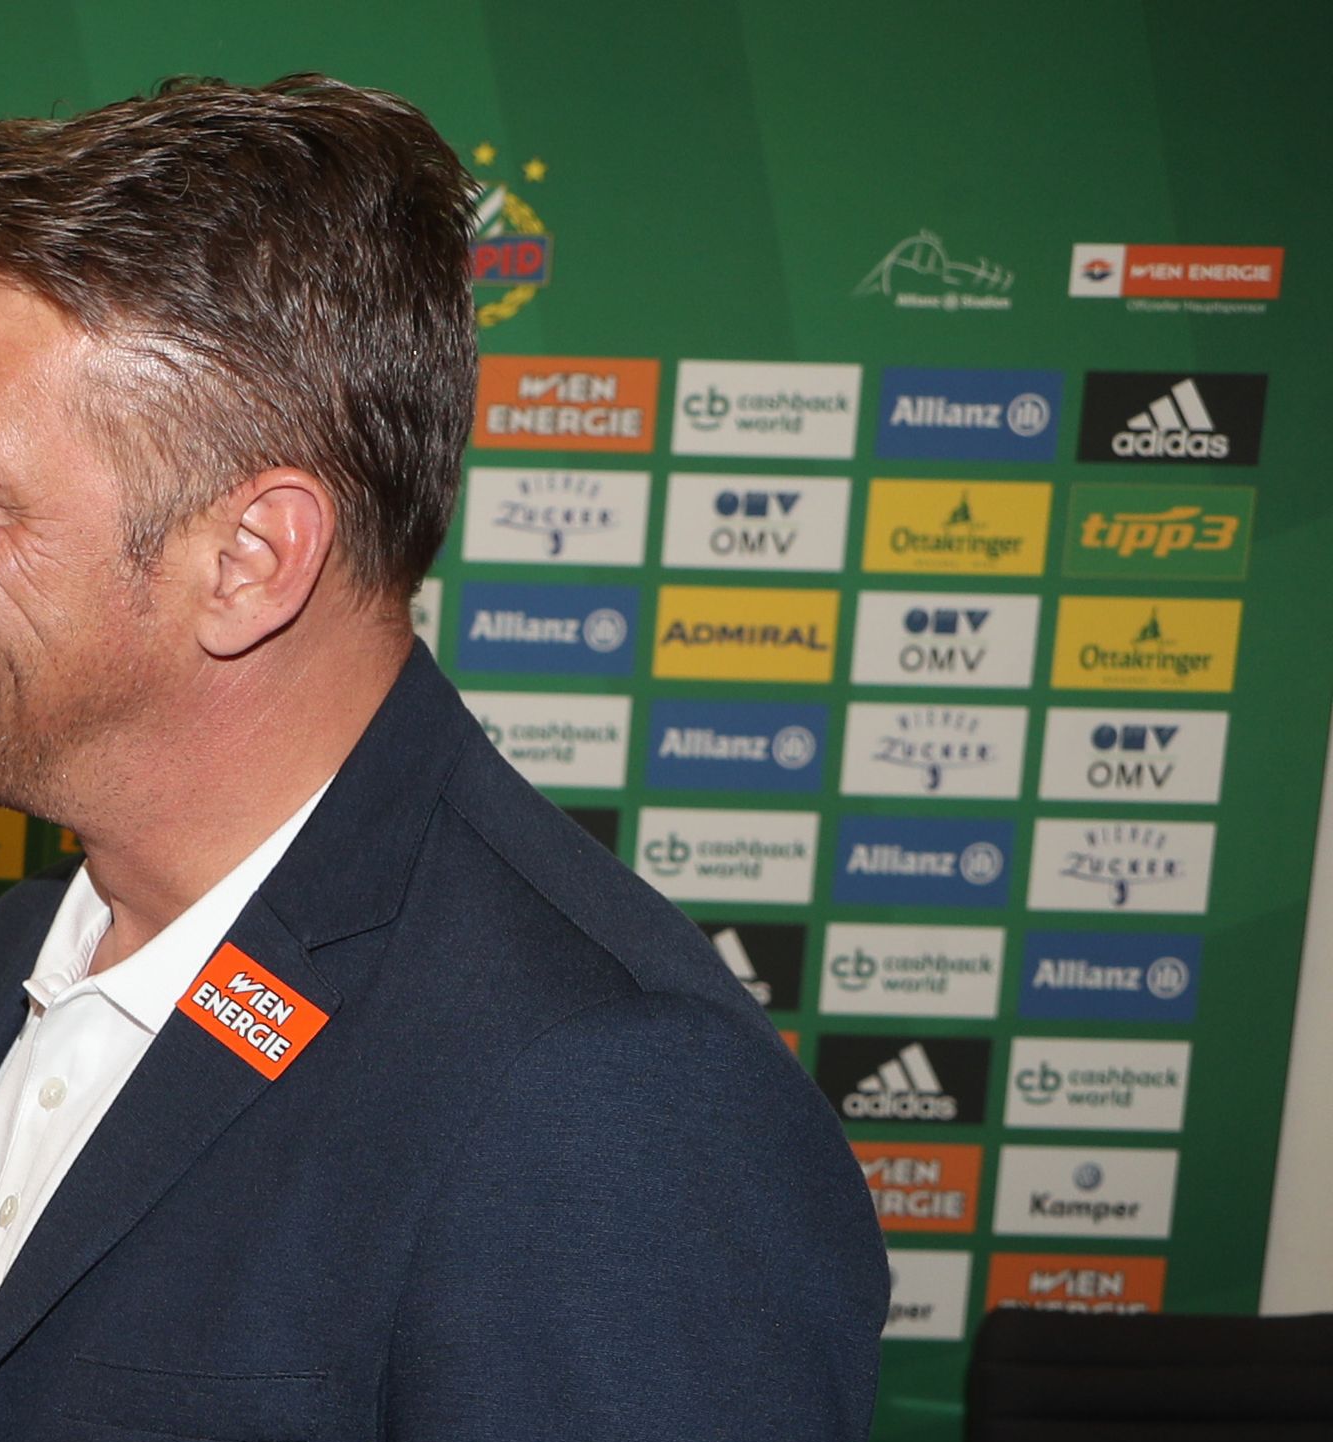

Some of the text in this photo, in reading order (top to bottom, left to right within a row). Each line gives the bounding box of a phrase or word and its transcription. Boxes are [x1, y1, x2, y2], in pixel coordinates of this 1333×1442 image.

[473, 240, 543, 280] PID
[1189, 264, 1272, 283] ENERGIE
[519, 374, 616, 402] WIEN
[737, 389, 850, 413] cashback
[486, 405, 638, 437] ENERGIE
[737, 410, 803, 434] world
[890, 395, 1002, 428] Allianz
[1111, 428, 1229, 458] adidas
[710, 528, 795, 555] OMV
[890, 523, 1022, 560] Ottakringer
[1081, 506, 1239, 557] tipp3
[470, 610, 579, 643] Allianz
[663, 621, 829, 652] ADMIRAL
[899, 644, 985, 672] OMV
[1079, 640, 1212, 677] Ottakringer
[659, 727, 768, 760] Allianz
[1087, 761, 1173, 788] OMV
[847, 844, 956, 876] Allianz
[1033, 959, 1141, 991] Allianz
[226, 971, 296, 1028] WIEN
[190, 980, 293, 1063] ENERGIE
[842, 1086, 956, 1119] adidas
[1030, 1187, 1139, 1222] Kamper
